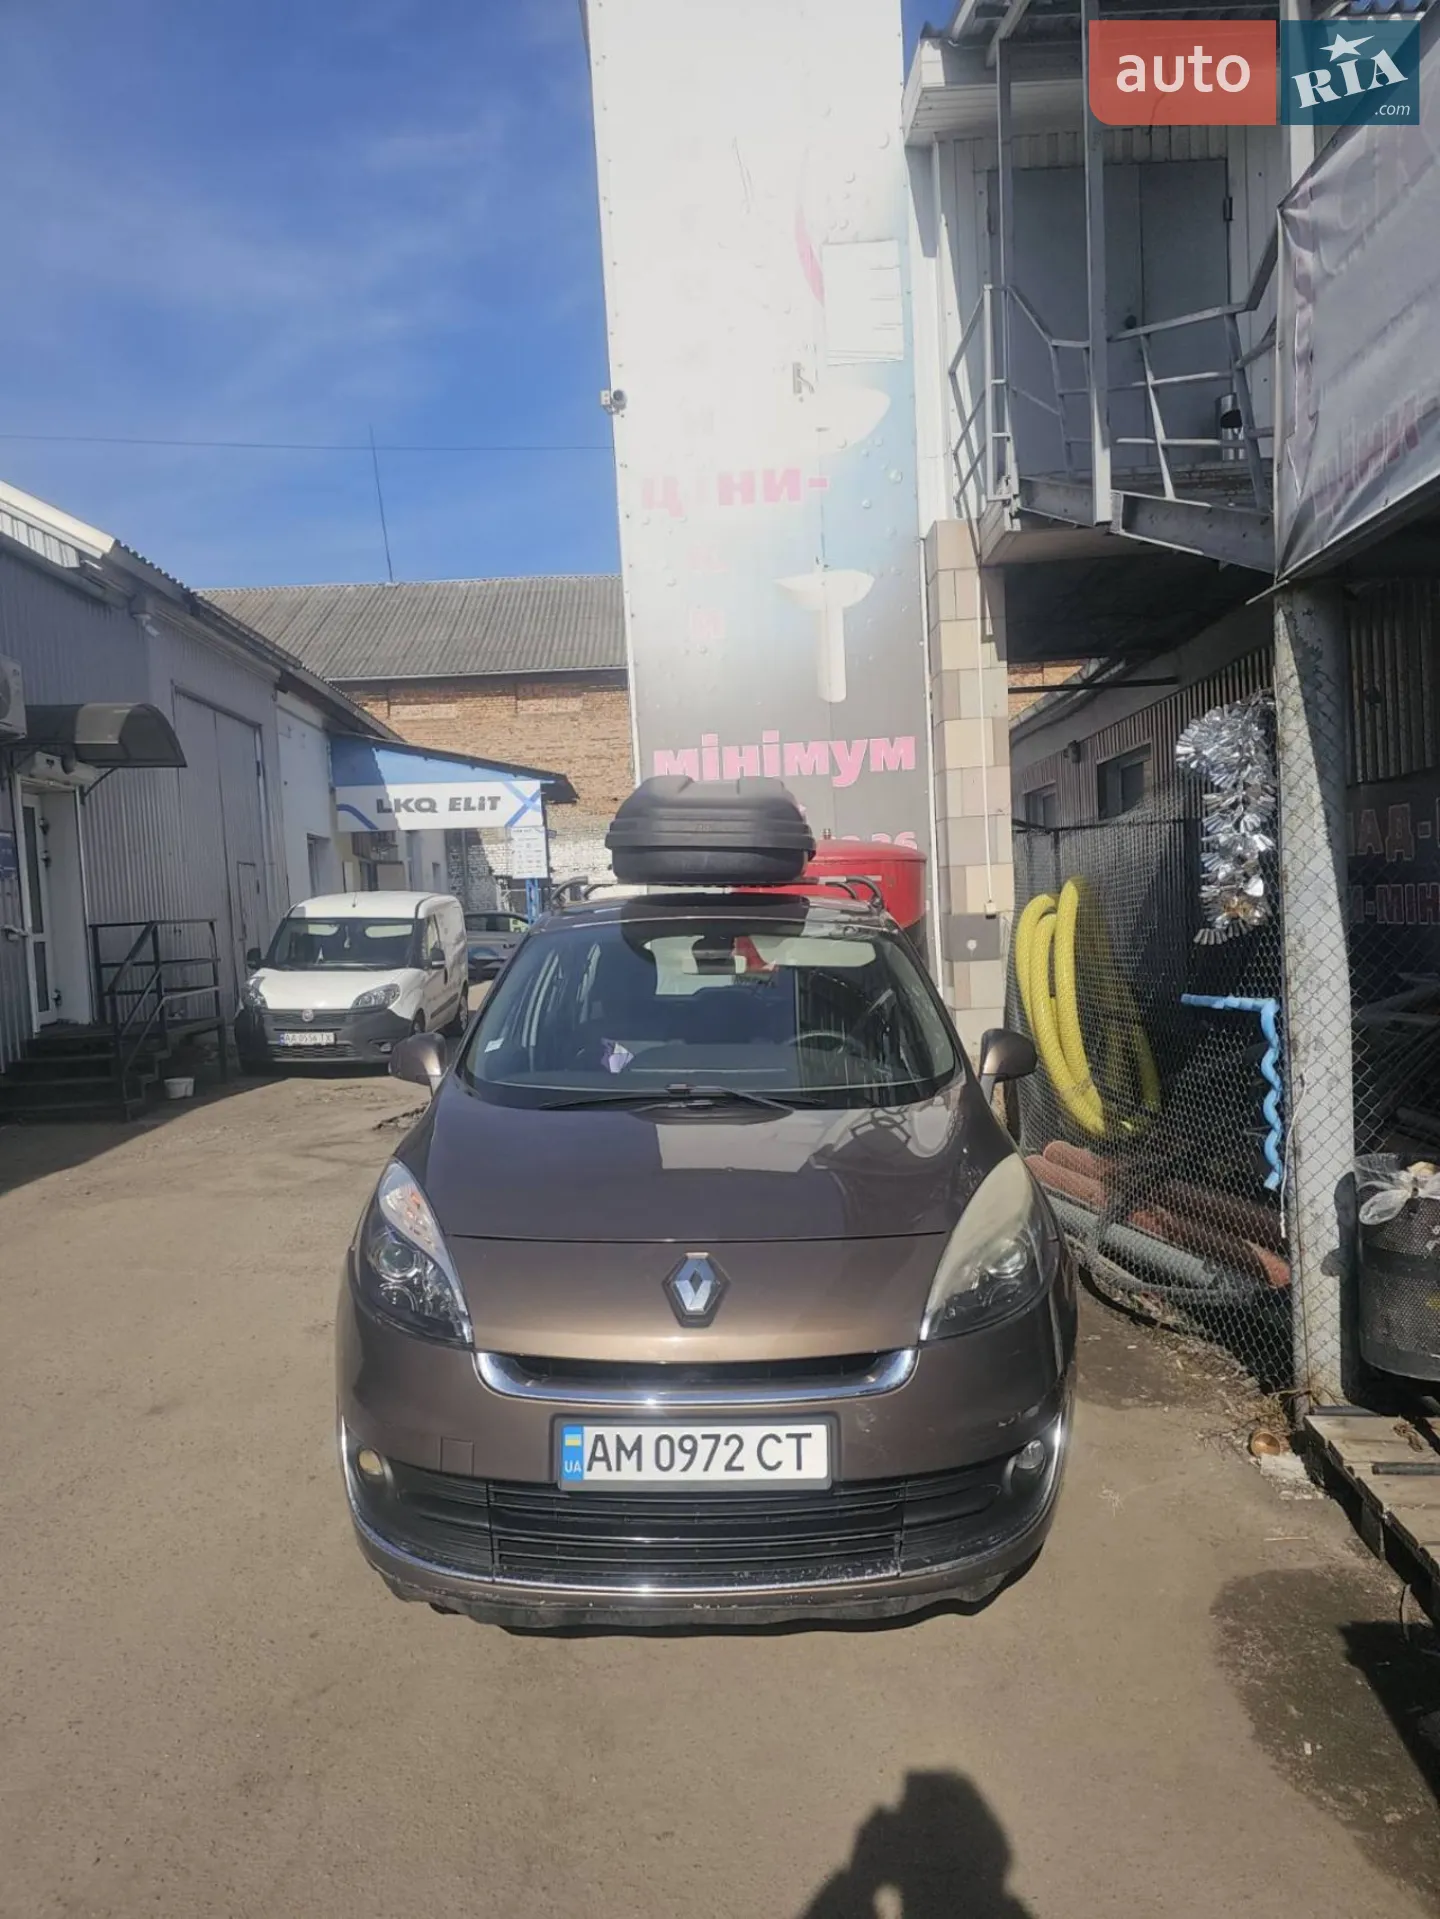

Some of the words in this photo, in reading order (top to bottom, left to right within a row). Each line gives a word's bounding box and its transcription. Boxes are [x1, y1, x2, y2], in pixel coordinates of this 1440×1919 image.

[653, 729, 916, 787] мінімум
[376, 797, 439, 814] LKQ
[564, 1460, 582, 1473] UA
[586, 1433, 643, 1472] AM
[654, 1433, 745, 1472] 0972
[756, 1433, 812, 1471] CT
